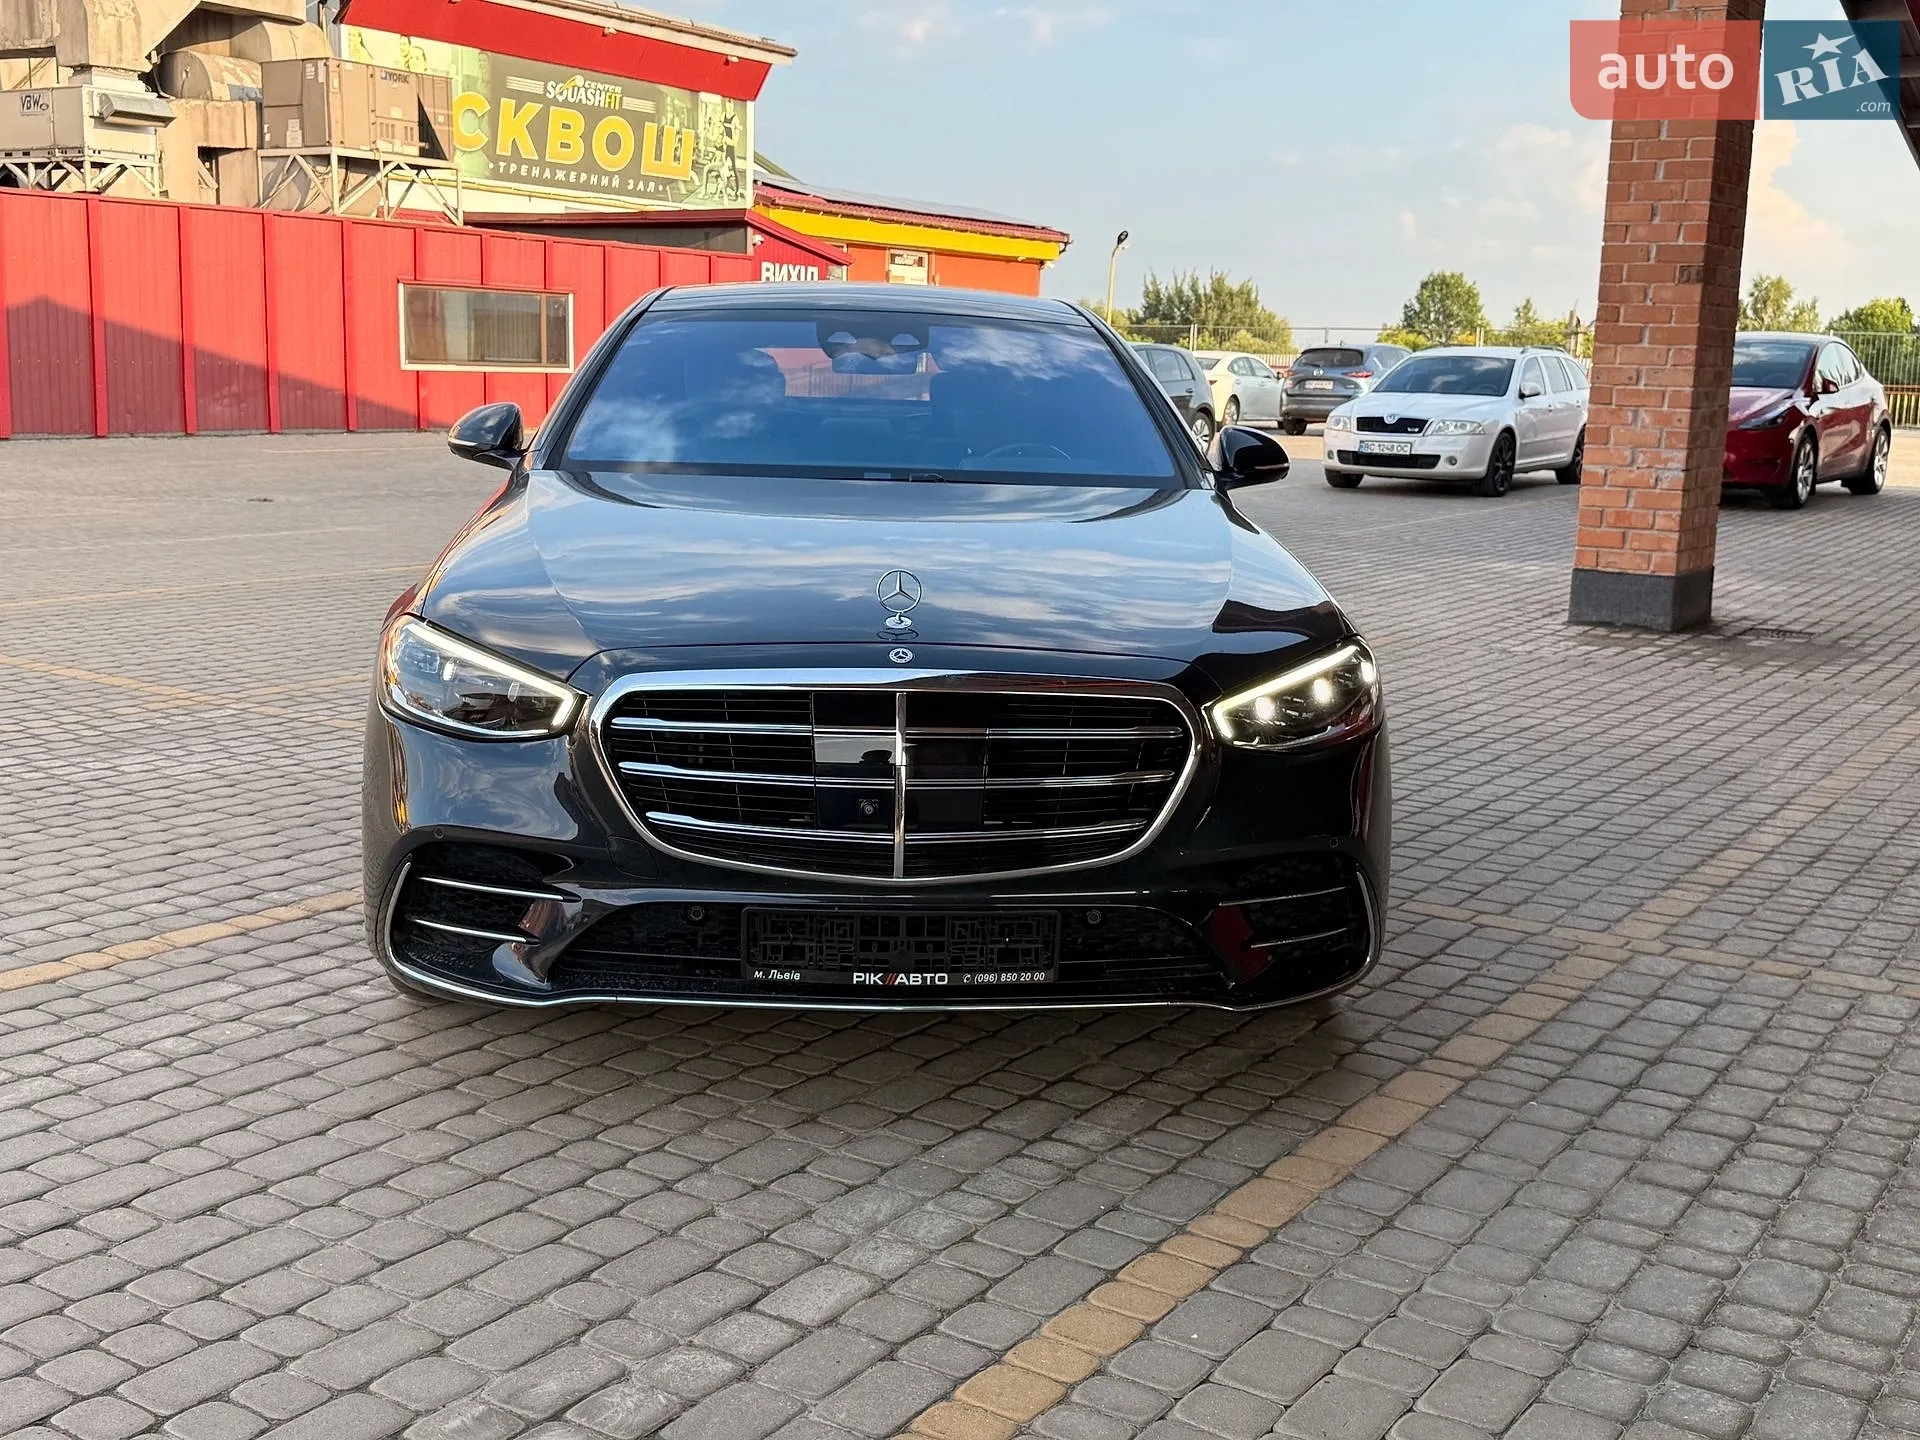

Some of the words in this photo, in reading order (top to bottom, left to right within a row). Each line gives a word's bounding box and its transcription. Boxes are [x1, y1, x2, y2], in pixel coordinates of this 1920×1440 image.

[388, 72, 410, 84] YORK
[584, 80, 622, 93] CENTER
[546, 80, 622, 110] SQUASHFIT
[453, 91, 695, 181] СКВОШ
[498, 161, 621, 189] ТРЕНАЖЕРНИЙ
[627, 179, 656, 193] ЗАЛ
[754, 970, 765, 979] м.
[769, 969, 800, 981] Львів
[974, 973, 998, 984] (096)
[1001, 973, 1018, 982] 850
[1020, 972, 1031, 981] 20
[1033, 972, 1045, 981] 00
